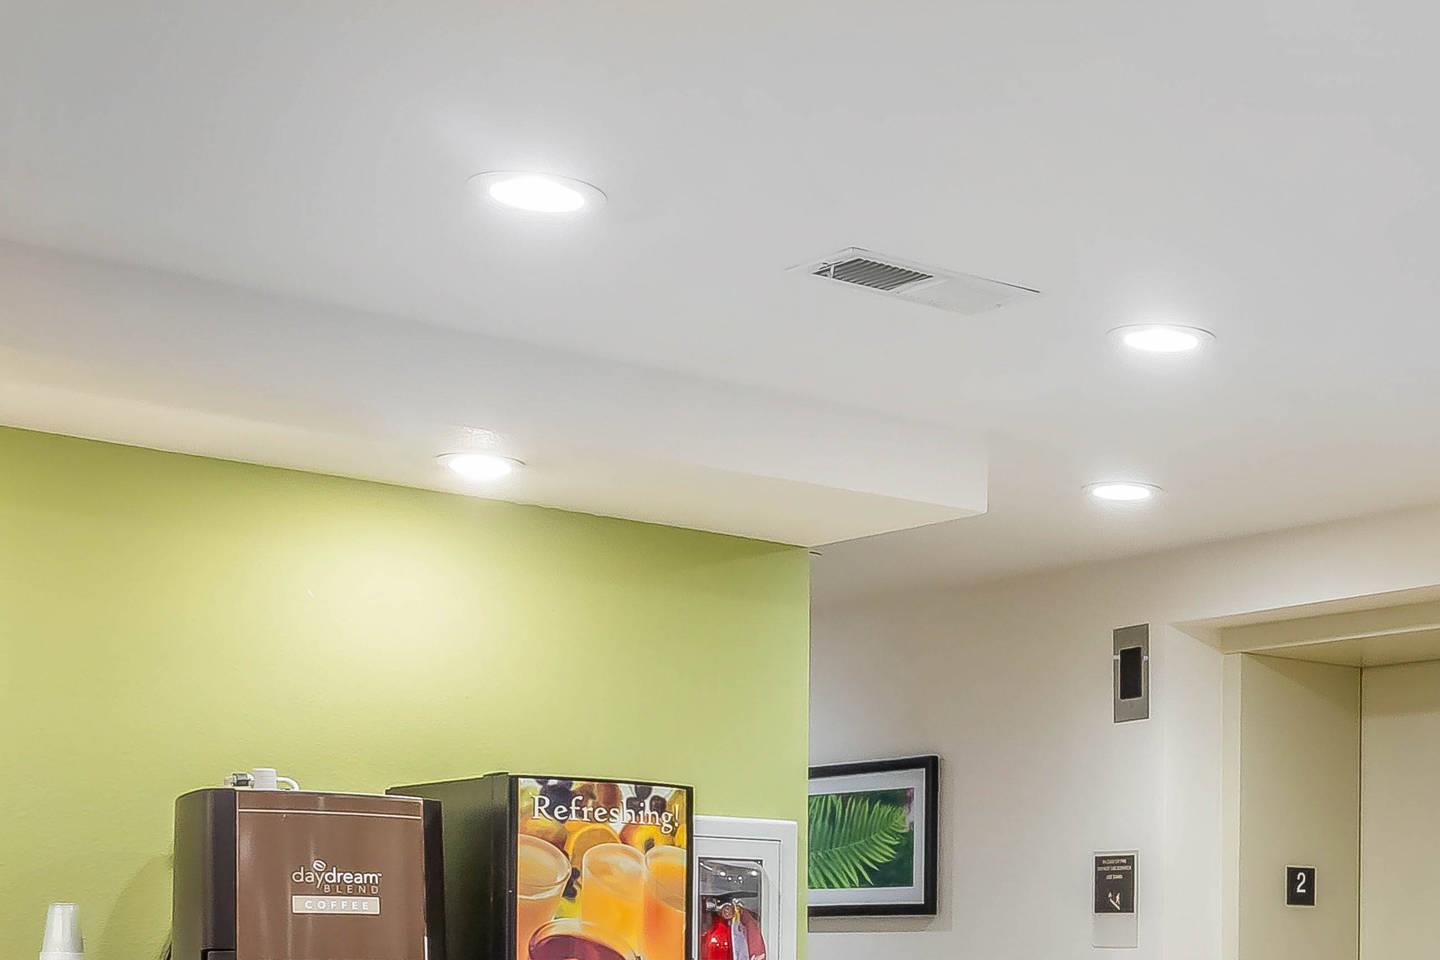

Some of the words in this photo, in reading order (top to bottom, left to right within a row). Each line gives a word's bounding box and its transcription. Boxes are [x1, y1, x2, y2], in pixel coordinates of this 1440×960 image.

[531, 795, 680, 834] Refreshing!
[292, 866, 379, 889] daydream
[1297, 872, 1306, 893] 2
[324, 884, 379, 894] BLEND
[304, 900, 369, 911] COFFEE
